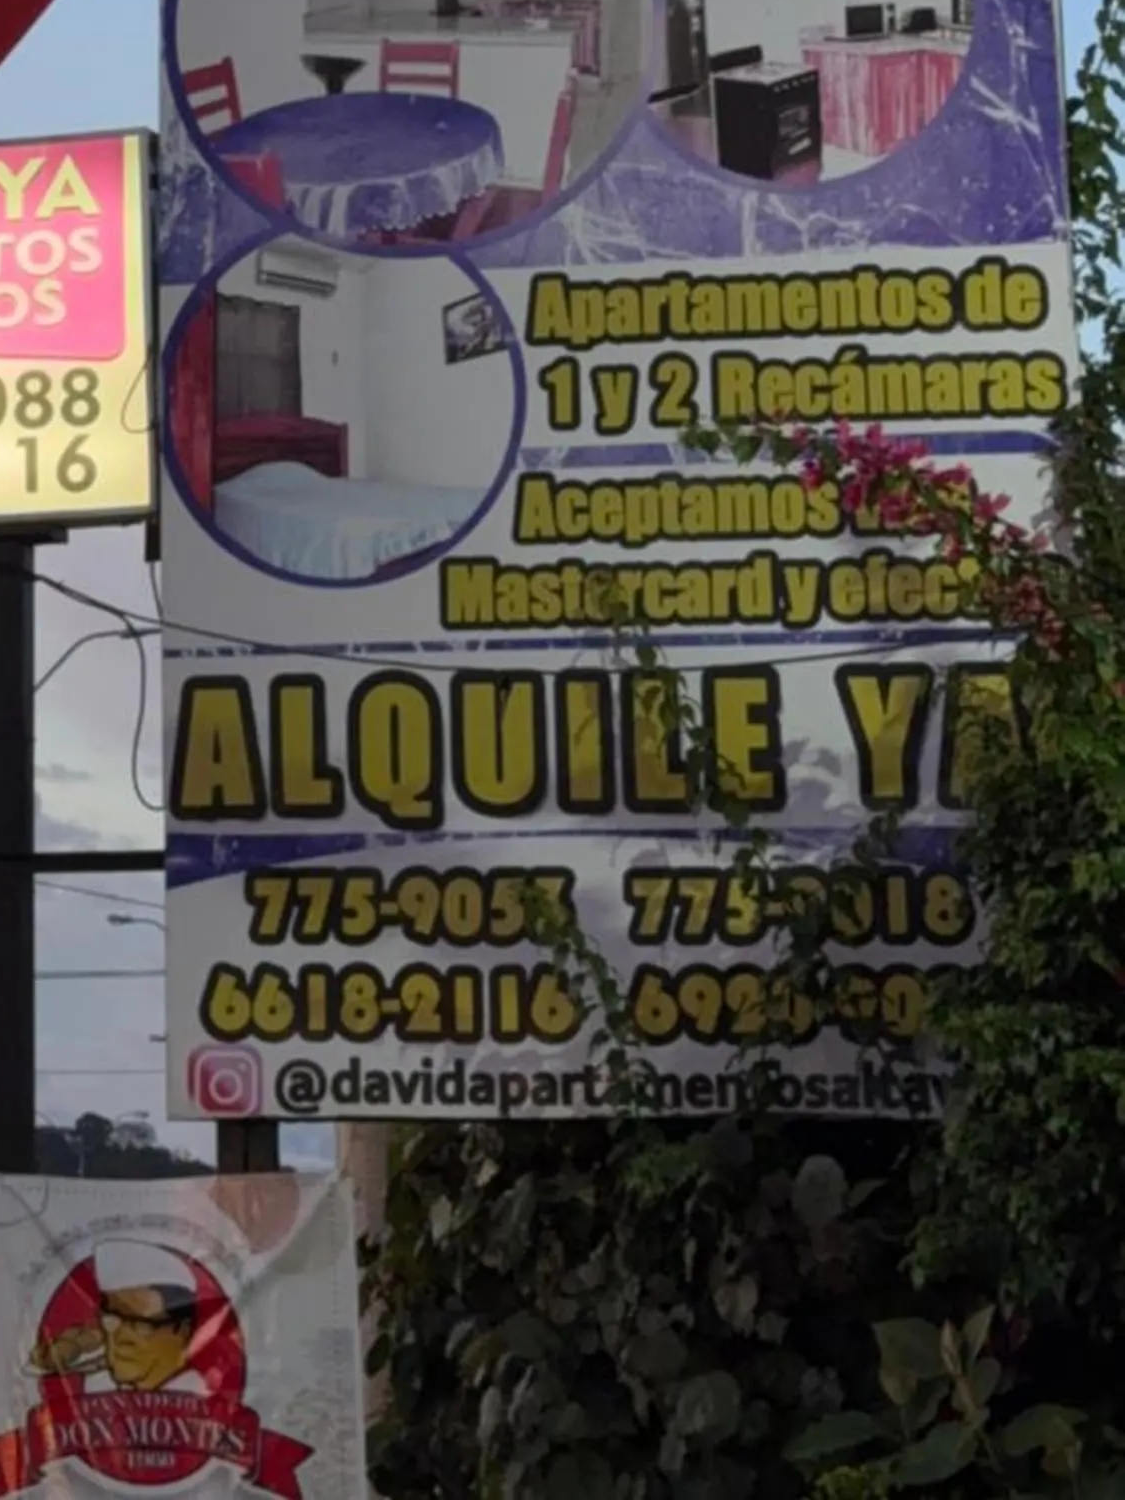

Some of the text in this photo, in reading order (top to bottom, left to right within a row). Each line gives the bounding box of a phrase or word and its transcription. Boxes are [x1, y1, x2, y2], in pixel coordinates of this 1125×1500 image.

[527, 255, 1047, 345] Apartamentos de
[538, 343, 1067, 435] 1 y 2 Recámaras
[514, 472, 845, 547] Aceptamos
[441, 550, 775, 629] Mastercard
[779, 564, 827, 627] y
[171, 666, 785, 826] ALQUILE
[201, 964, 582, 1042] 6618-2116
